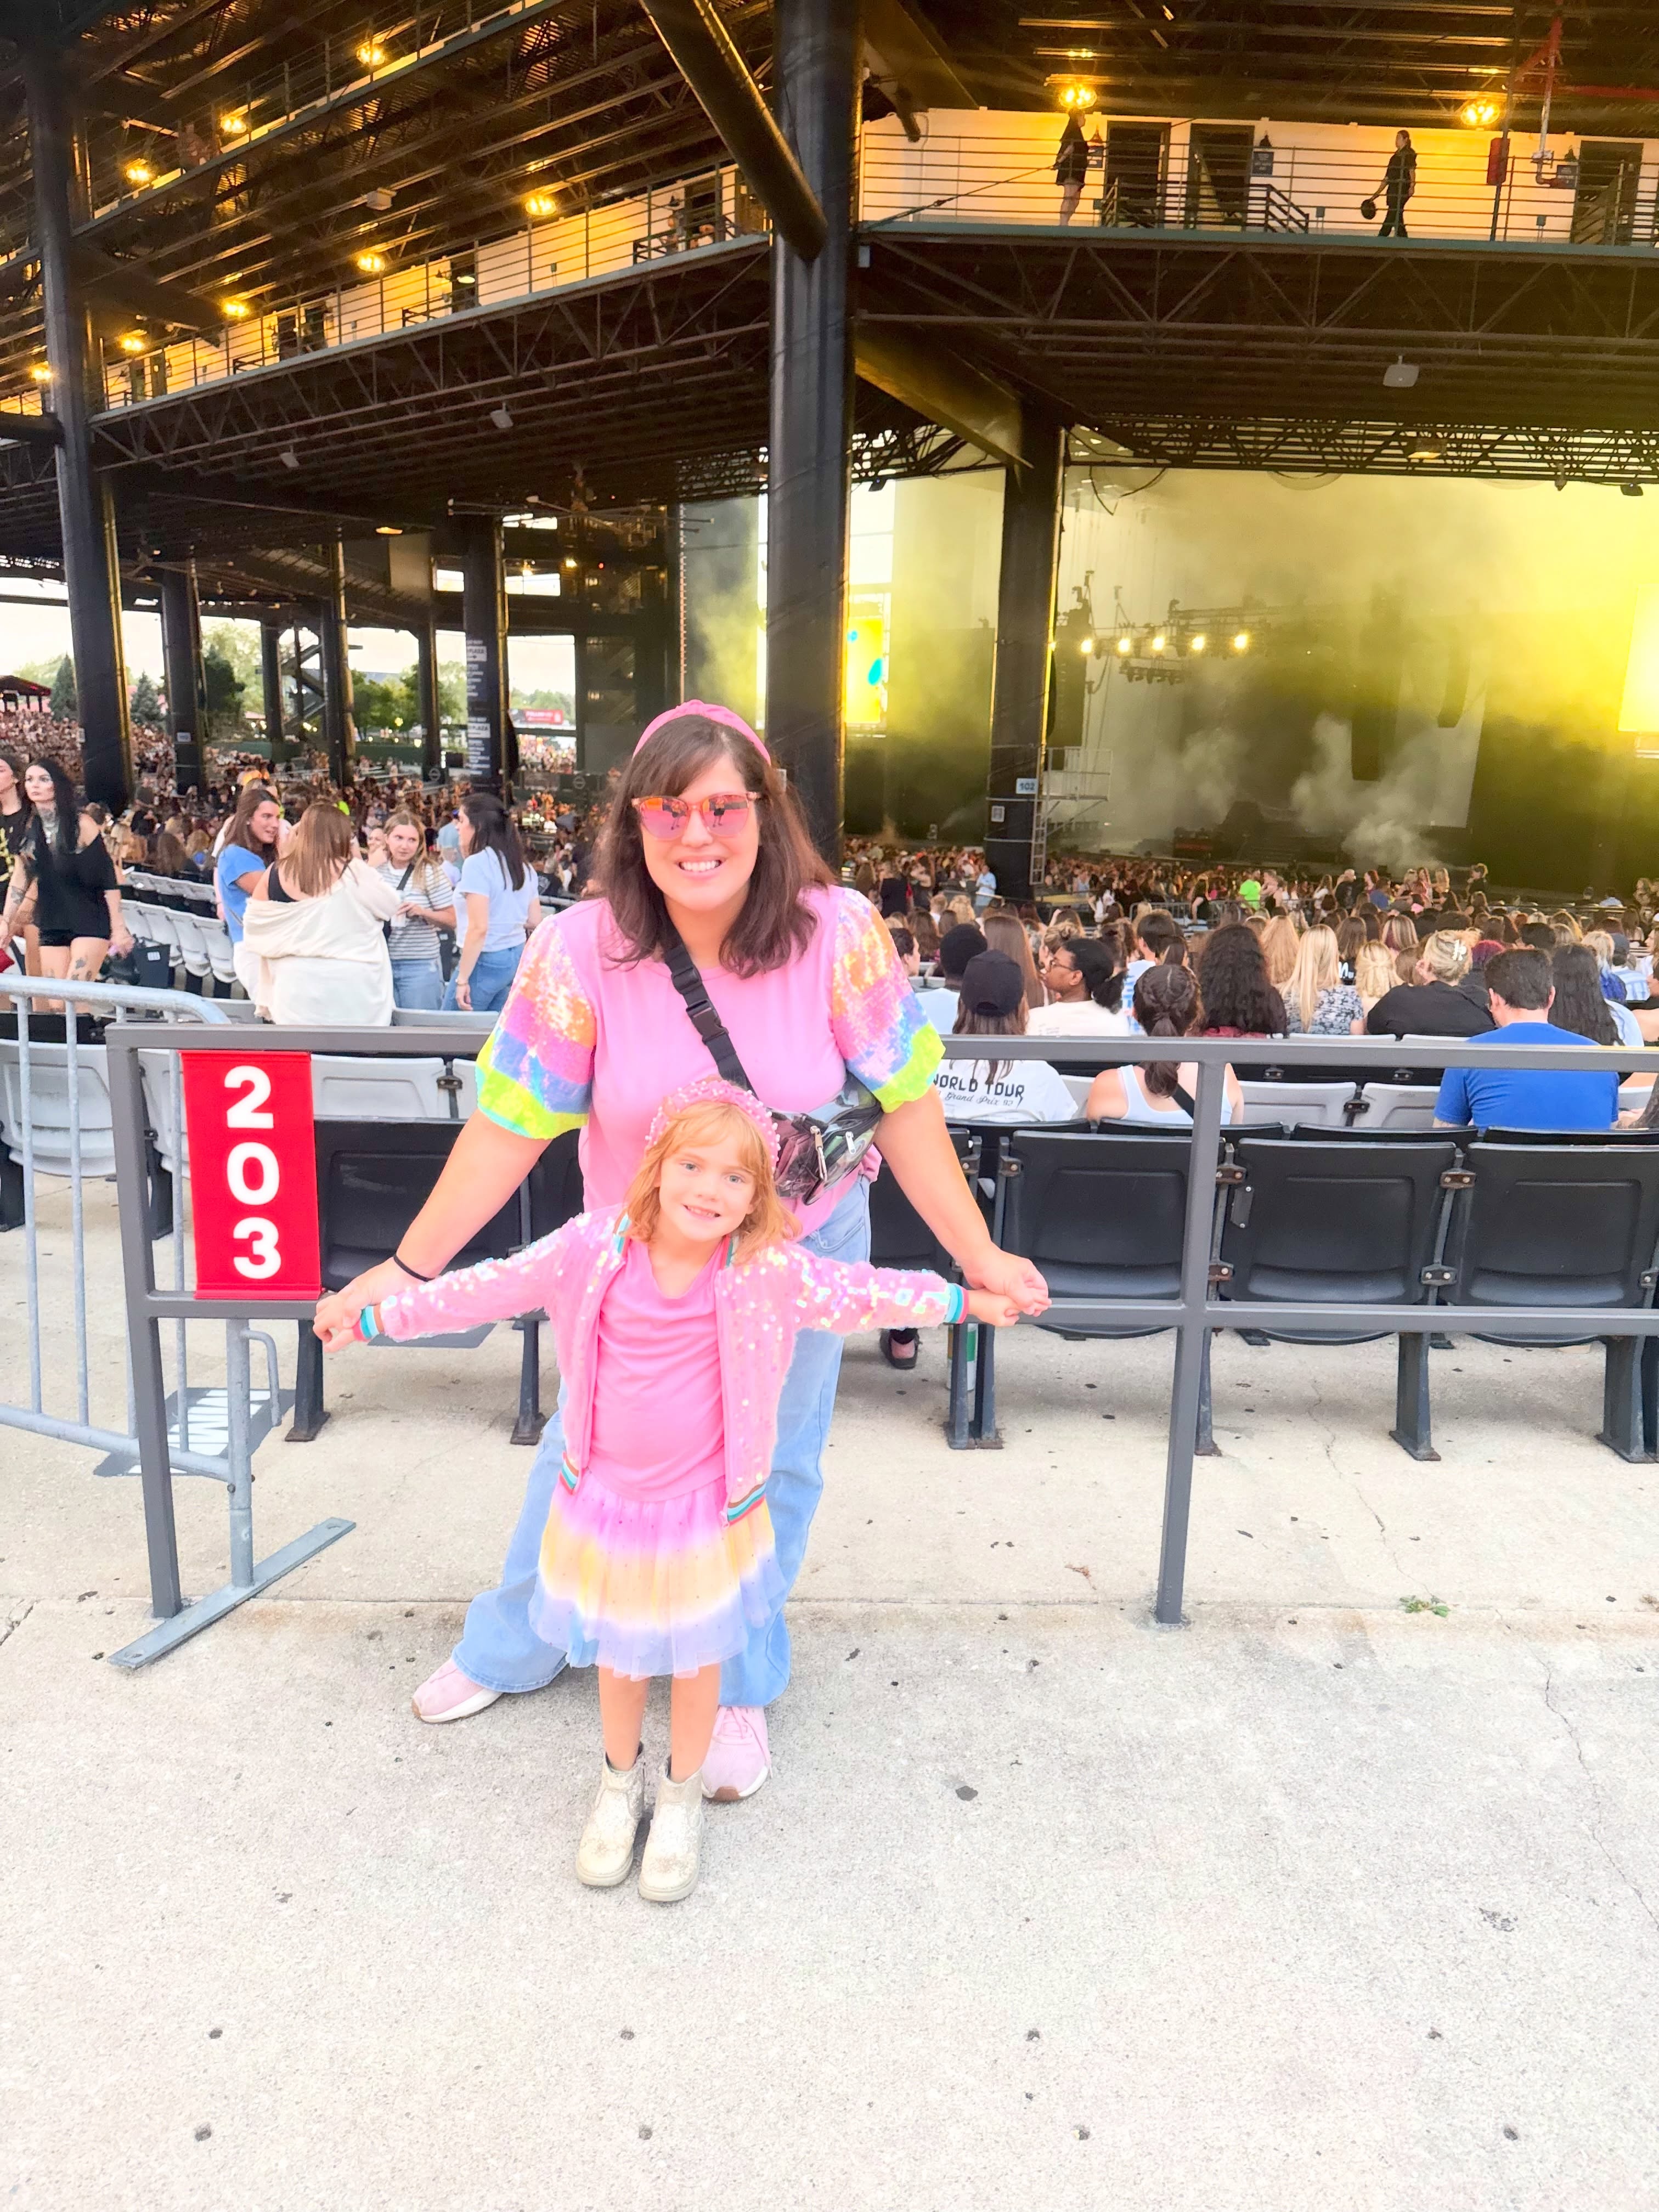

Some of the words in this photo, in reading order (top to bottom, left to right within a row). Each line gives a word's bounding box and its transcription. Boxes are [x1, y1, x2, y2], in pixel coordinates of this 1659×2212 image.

[945, 1092, 975, 1102] Grand
[976, 1096, 999, 1105] Prix
[985, 1079, 1025, 1107] TOUR
[224, 1065, 281, 1279] 203
